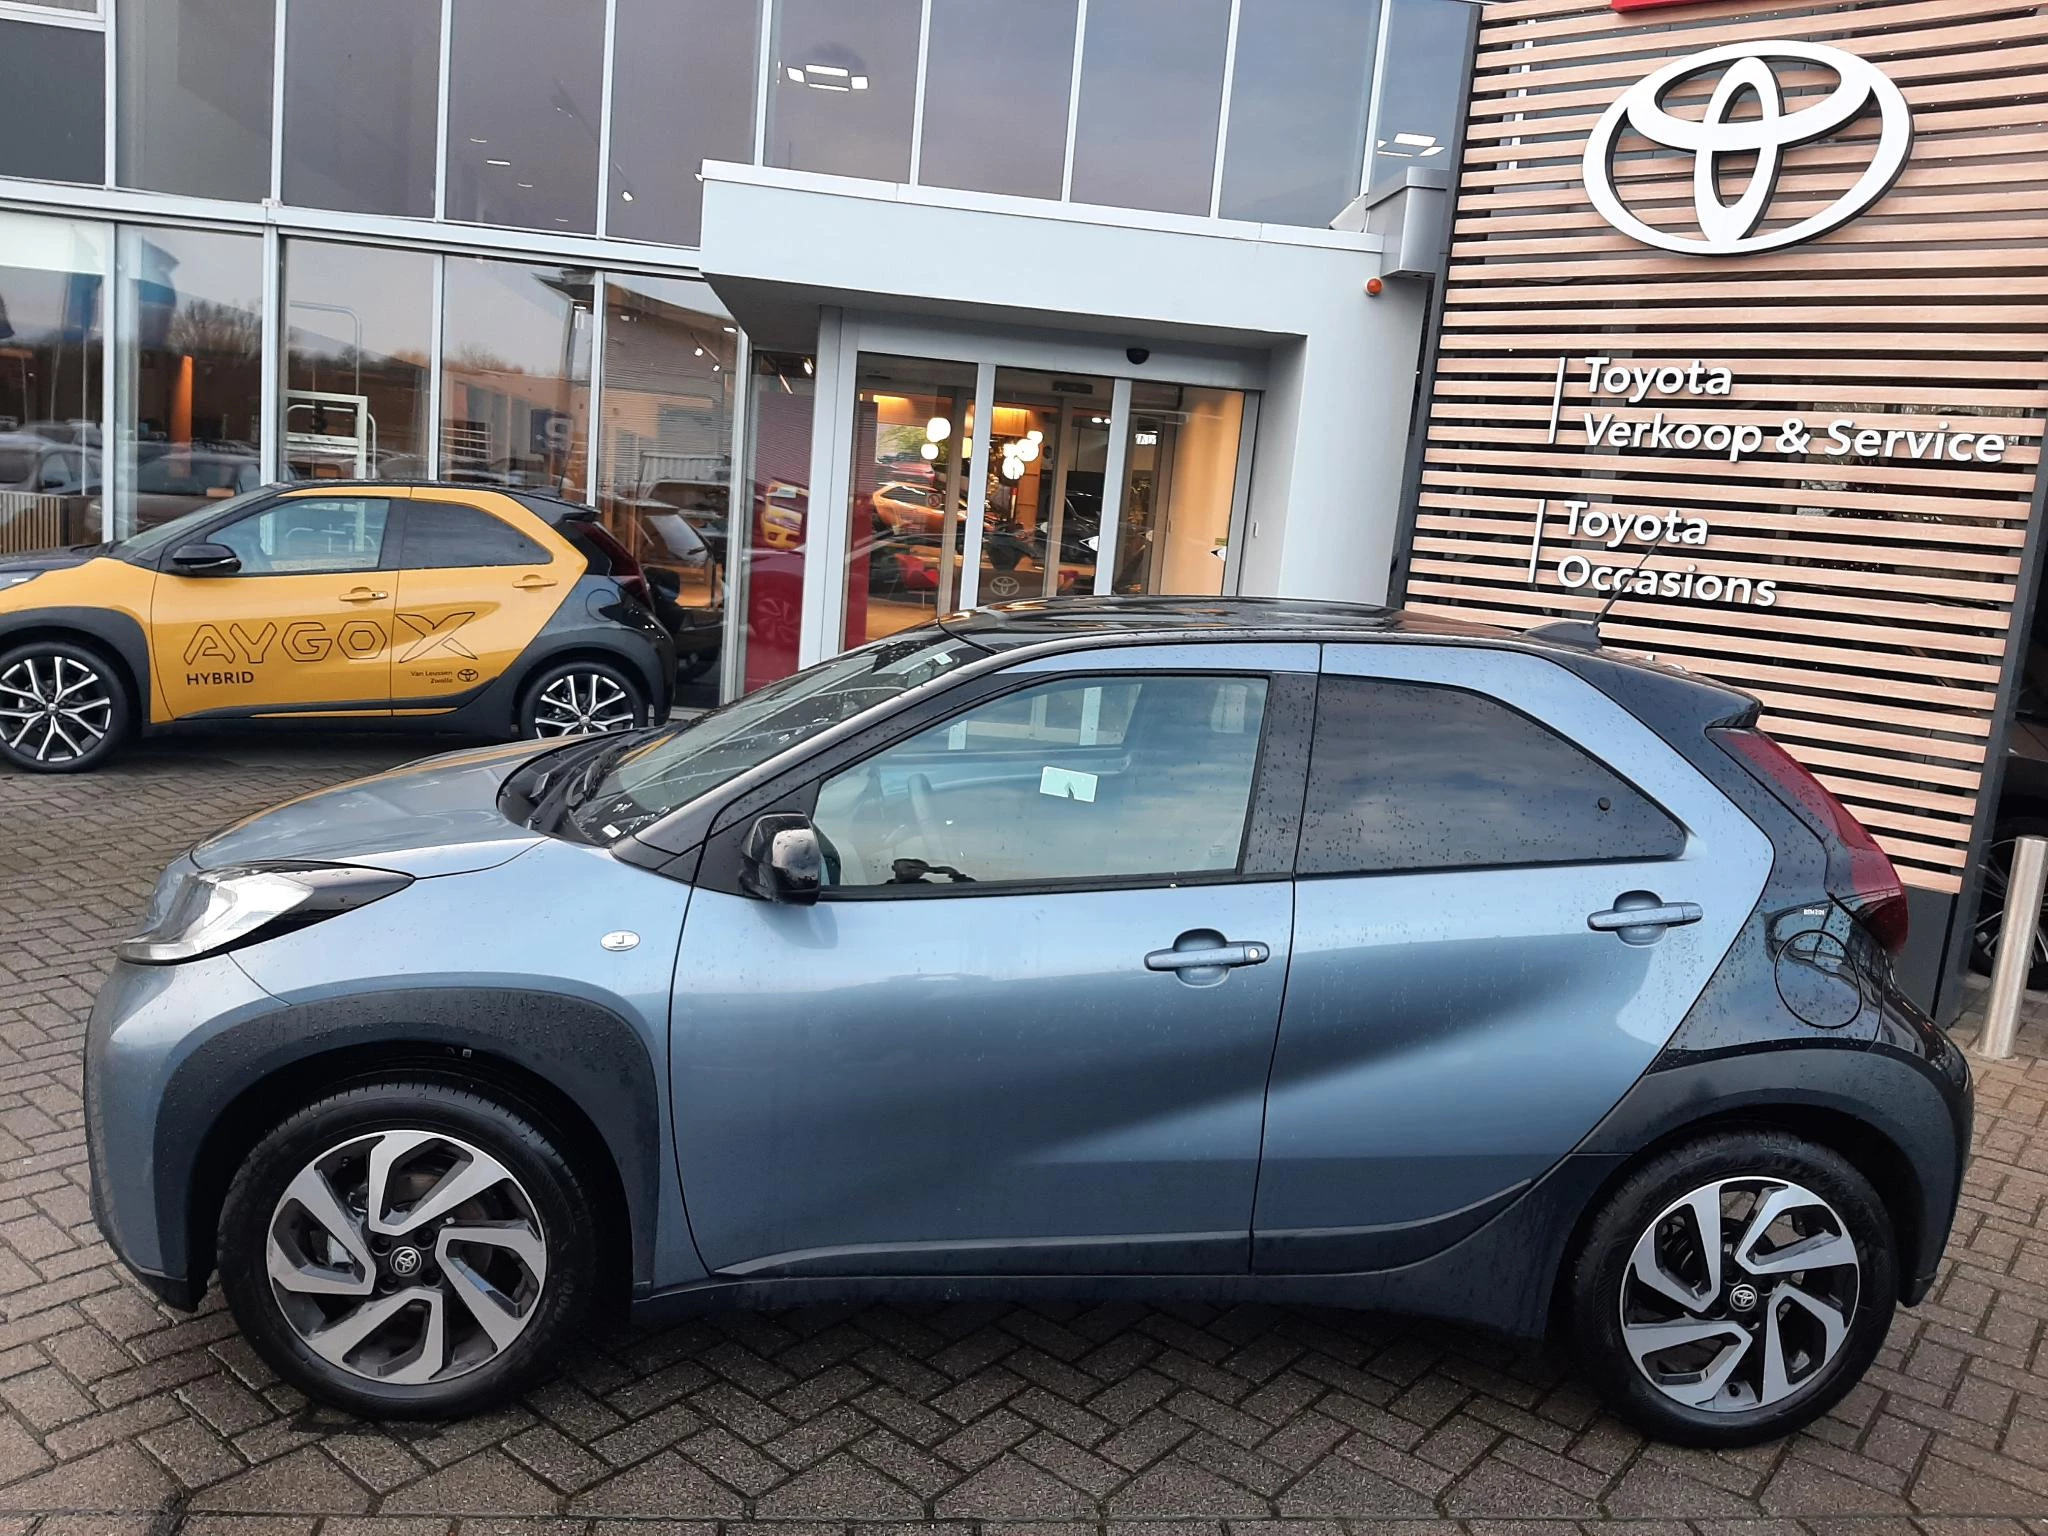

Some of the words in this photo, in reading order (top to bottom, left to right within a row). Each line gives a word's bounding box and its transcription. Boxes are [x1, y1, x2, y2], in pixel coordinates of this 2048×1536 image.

[1584, 356, 1733, 403] Toyota
[1583, 411, 1764, 462] Verkoop
[1775, 417, 1812, 454] &
[1823, 419, 2006, 463] Service
[1563, 500, 1709, 548] Toyota
[1557, 554, 1778, 607] Occasions
[186, 671, 254, 686] HYBRID
